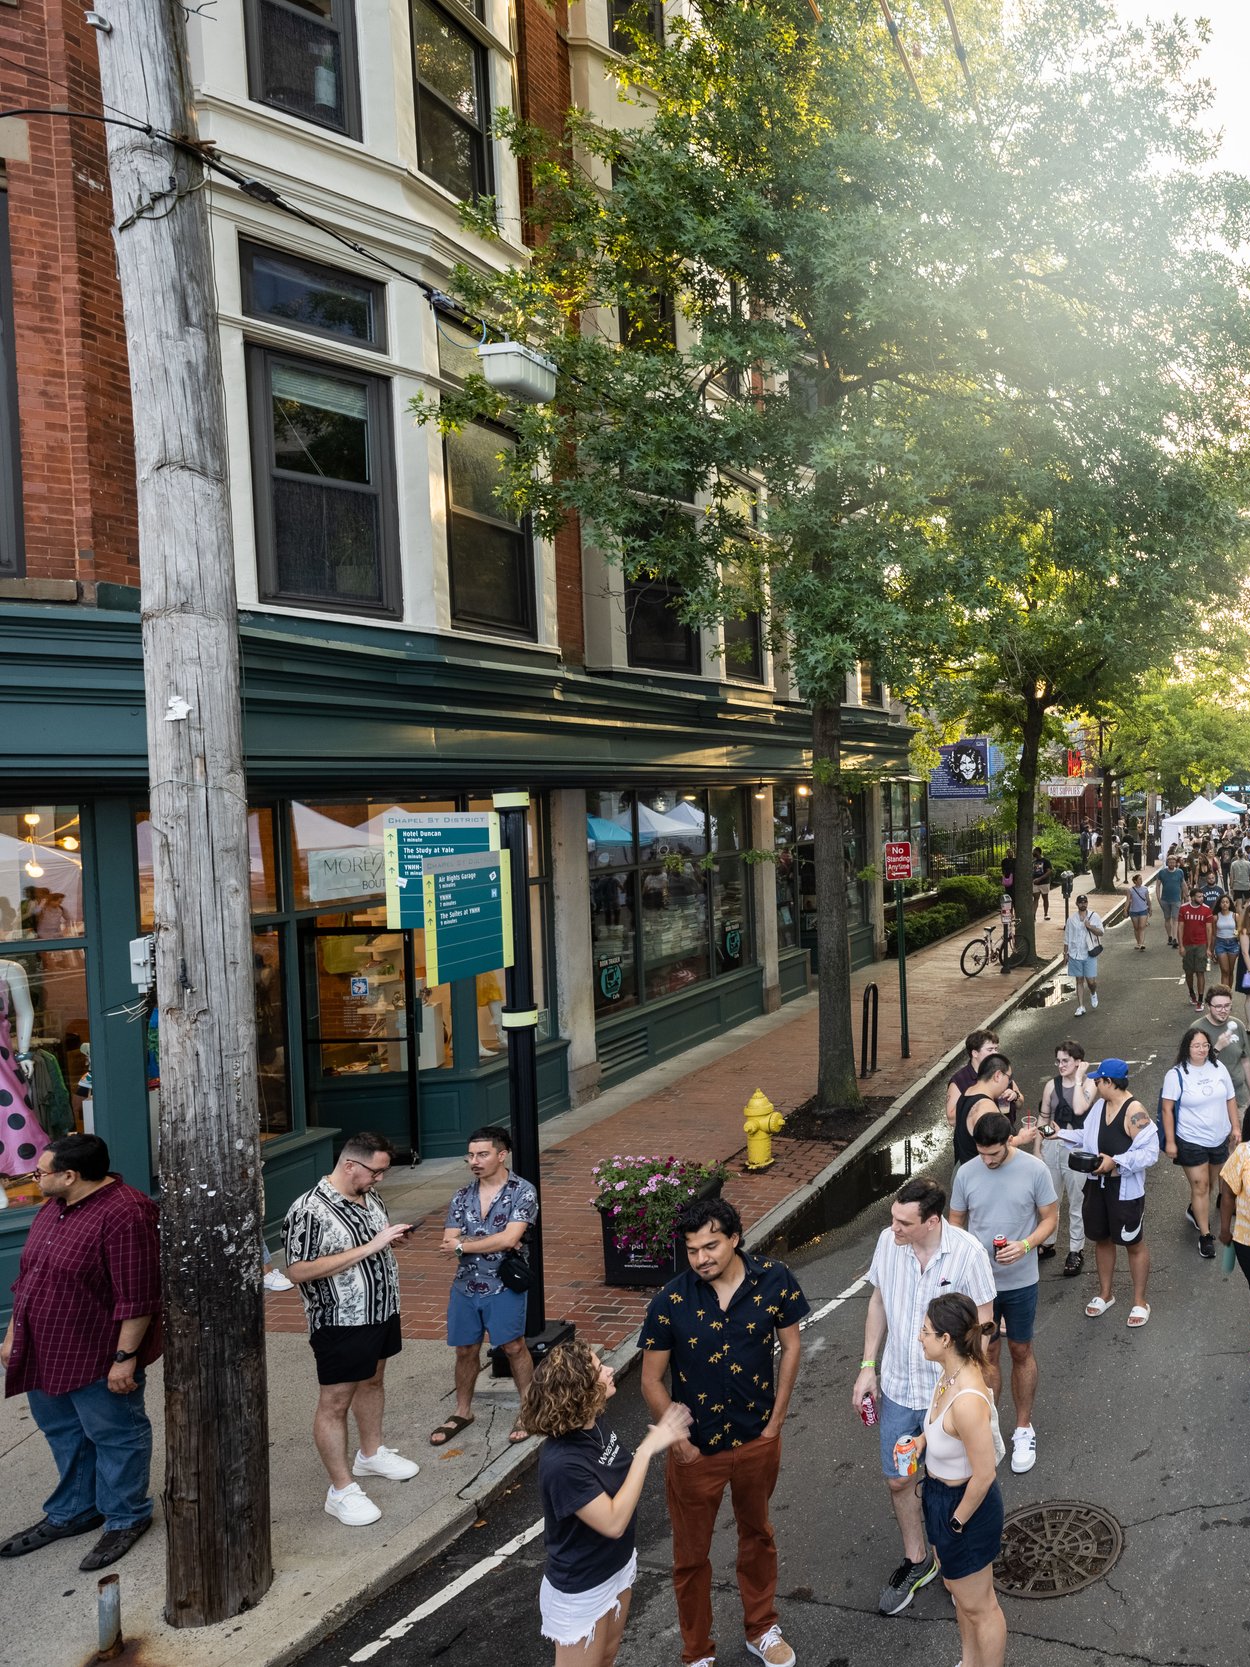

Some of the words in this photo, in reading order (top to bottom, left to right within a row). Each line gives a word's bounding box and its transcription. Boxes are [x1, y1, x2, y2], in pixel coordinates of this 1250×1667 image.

[446, 874, 461, 882] Rights
[460, 872, 476, 880] Garage
[449, 910, 463, 918] Suites
